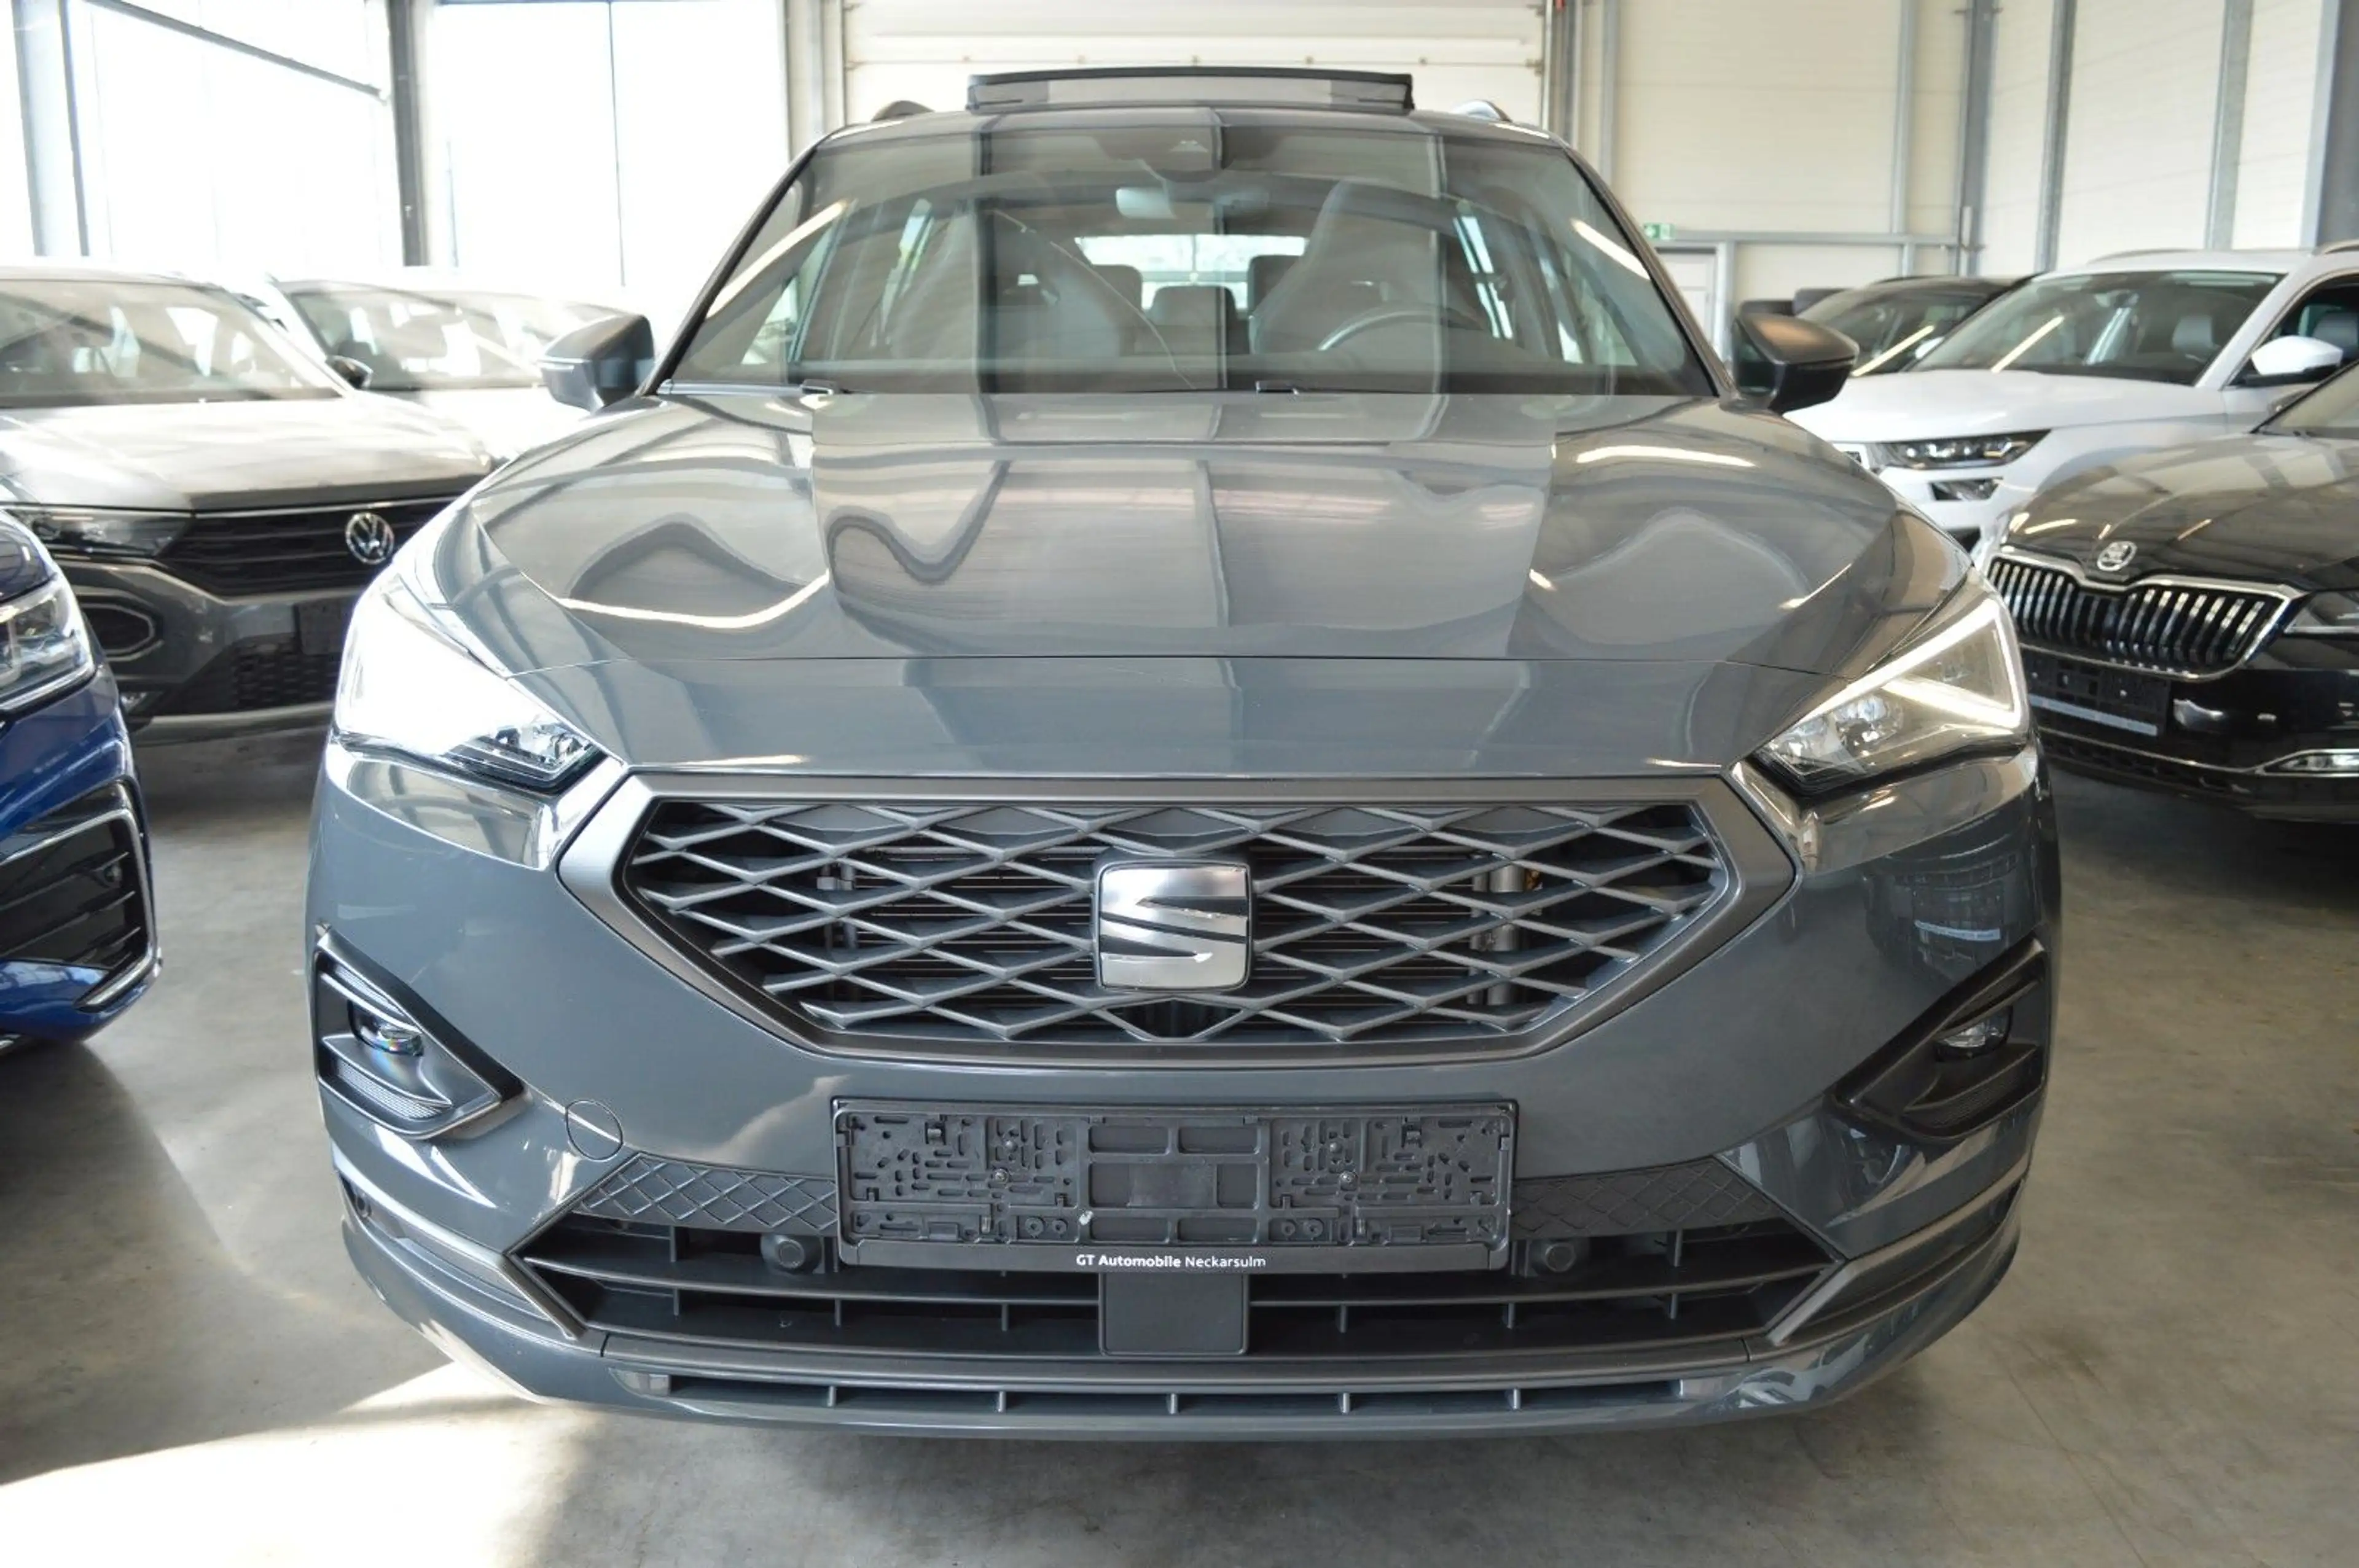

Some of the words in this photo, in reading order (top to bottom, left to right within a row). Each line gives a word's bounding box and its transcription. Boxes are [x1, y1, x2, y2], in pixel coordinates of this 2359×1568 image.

[1076, 1254, 1095, 1266] GT
[1098, 1254, 1181, 1268] Automobile
[1185, 1255, 1266, 1268] Neckarsulm
